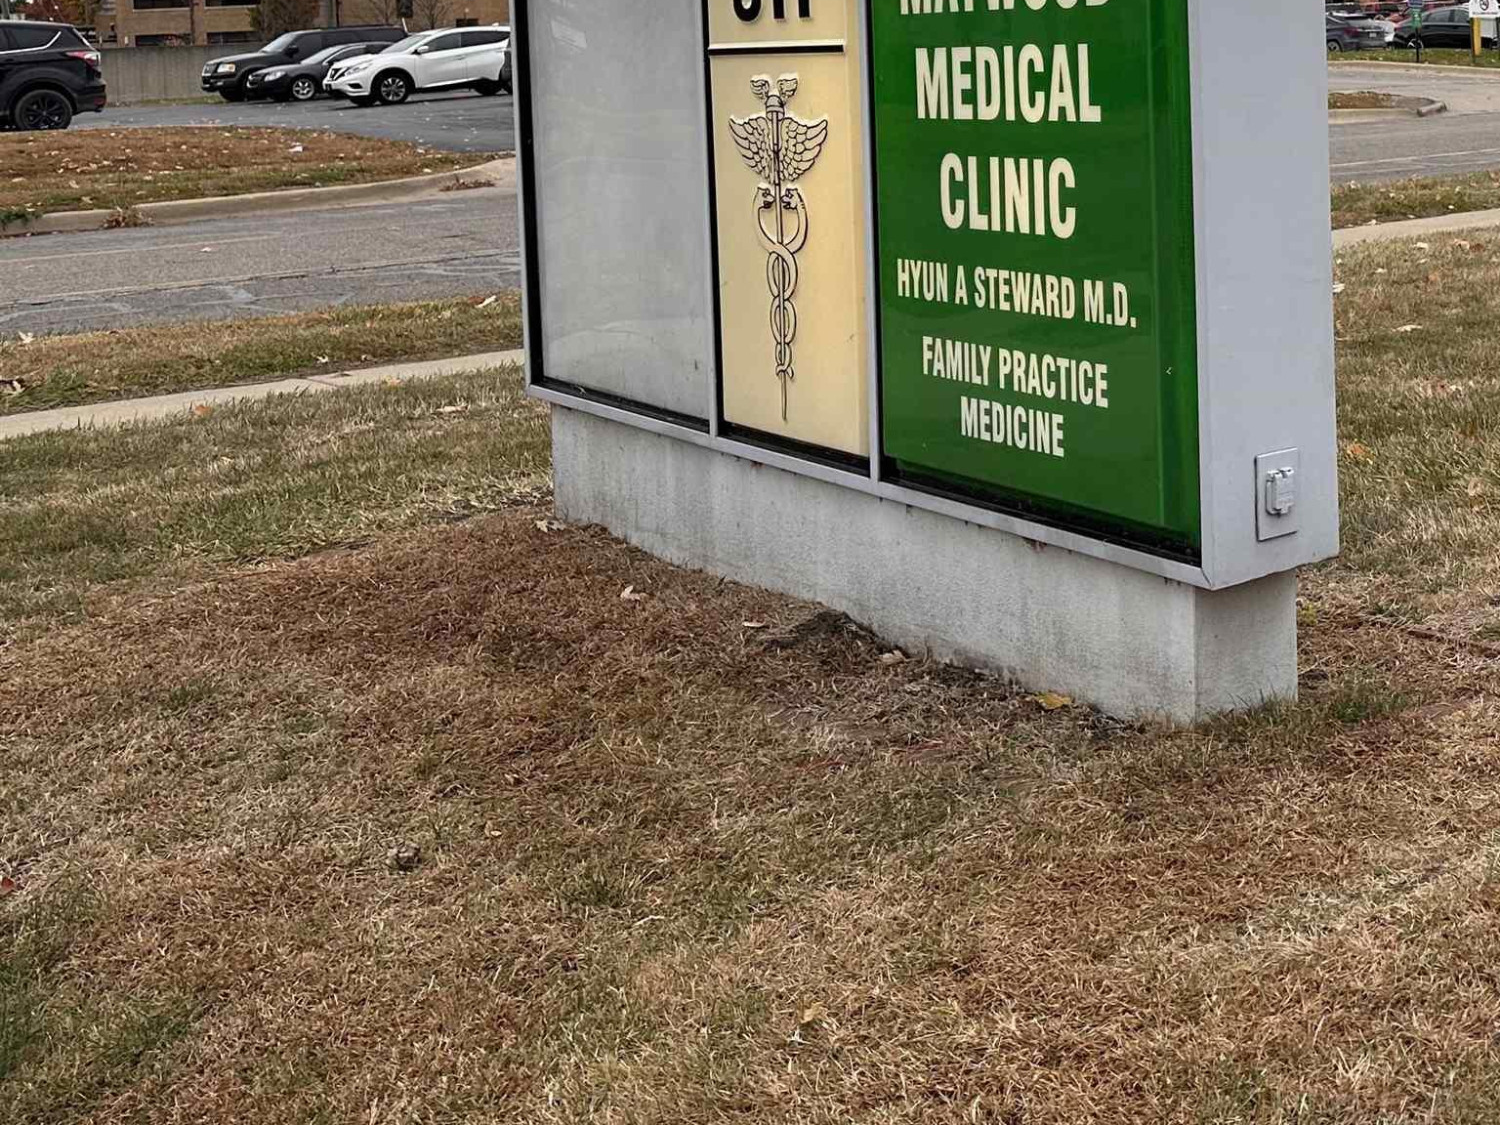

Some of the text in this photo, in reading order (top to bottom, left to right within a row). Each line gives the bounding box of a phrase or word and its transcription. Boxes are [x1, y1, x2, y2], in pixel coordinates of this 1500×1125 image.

[915, 43, 1102, 123] MEDICAL
[940, 152, 1076, 239] CLINIC
[897, 258, 1137, 328] HYUN A STEWARD M.D.
[922, 335, 1109, 409] FAMILY PRACTICE
[960, 395, 1066, 457] MEDICINE
